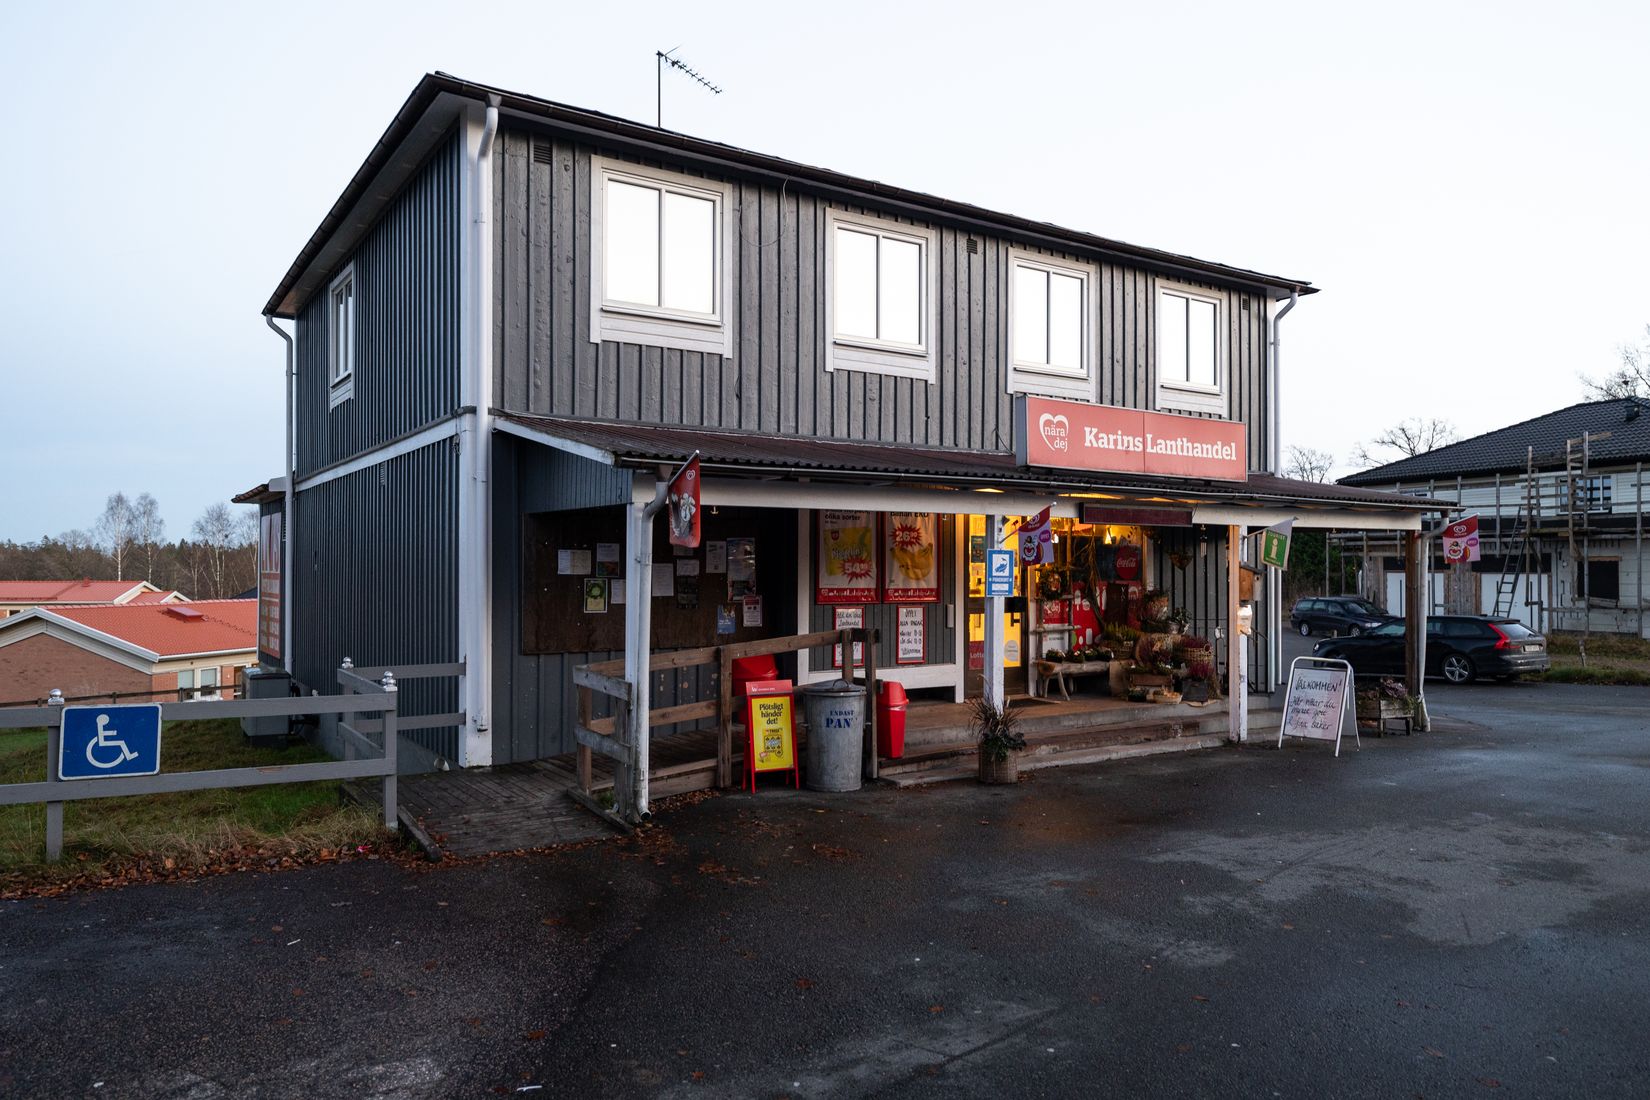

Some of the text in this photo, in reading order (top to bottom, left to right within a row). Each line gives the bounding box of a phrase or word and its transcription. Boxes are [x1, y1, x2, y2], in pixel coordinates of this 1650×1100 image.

[1044, 425, 1066, 437] nära
[1053, 437, 1068, 453] dej
[1084, 426, 1237, 461] Karins Lanthandel
[759, 702, 784, 711] Plötsligt
[760, 710, 782, 718] händer
[766, 717, 779, 725] det!
